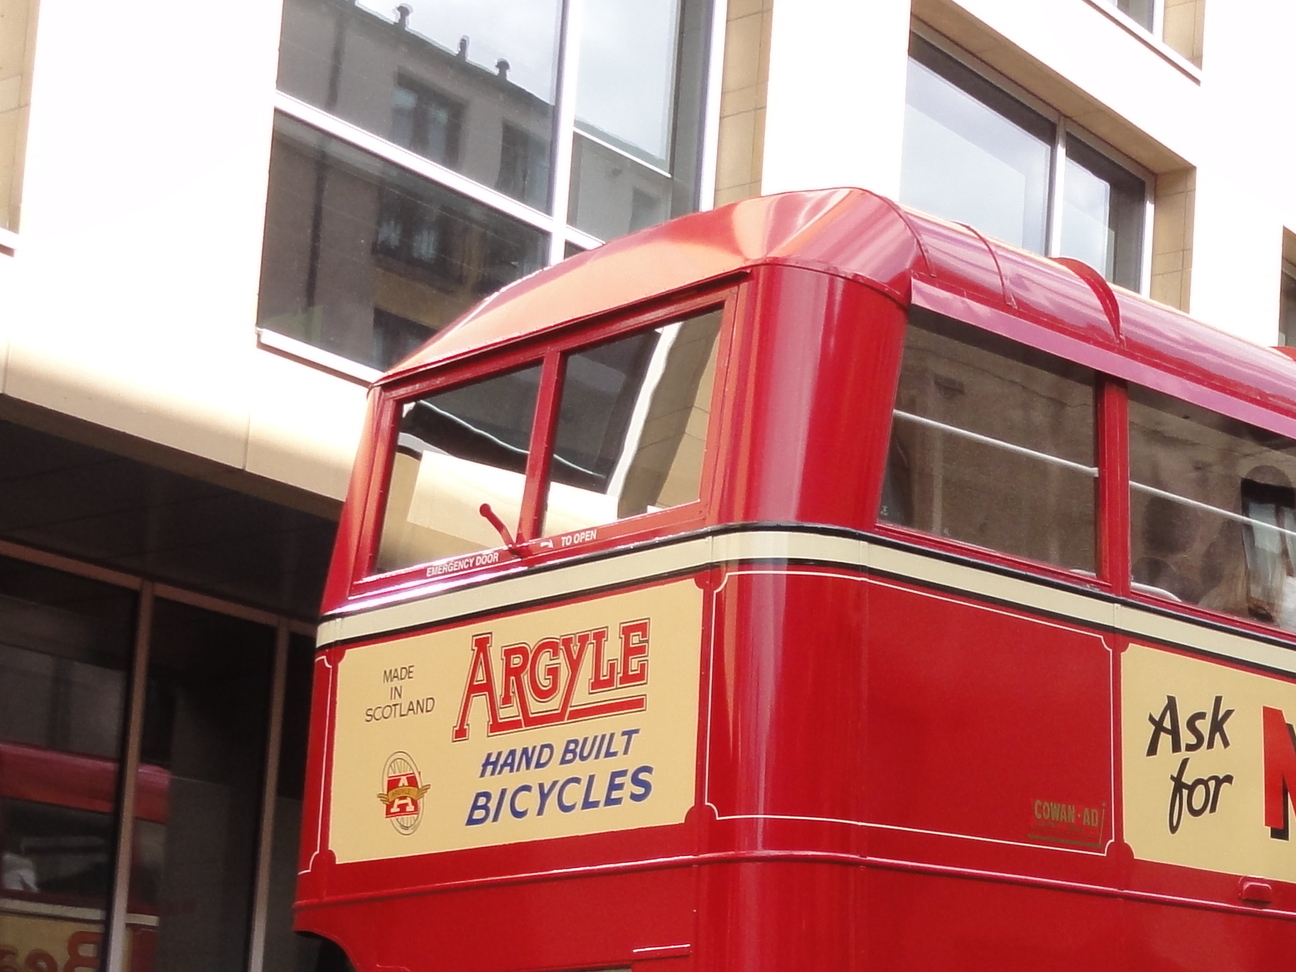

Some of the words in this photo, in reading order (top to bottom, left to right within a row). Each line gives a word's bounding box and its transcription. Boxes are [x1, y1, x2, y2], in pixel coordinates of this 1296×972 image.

[561, 536, 573, 547] TO
[574, 530, 597, 544] OPEN
[426, 558, 474, 577] EMERGENCY
[475, 552, 499, 567] DOOR
[383, 665, 415, 683] MADE
[390, 685, 403, 700] IN
[452, 617, 650, 743] ARGYLE
[365, 697, 436, 722] SCOTLAND
[1146, 695, 1232, 758] Ask
[479, 743, 555, 778] HAND
[559, 728, 640, 766] BUILT
[465, 765, 654, 826] BICYCLES
[1168, 757, 1235, 834] for
